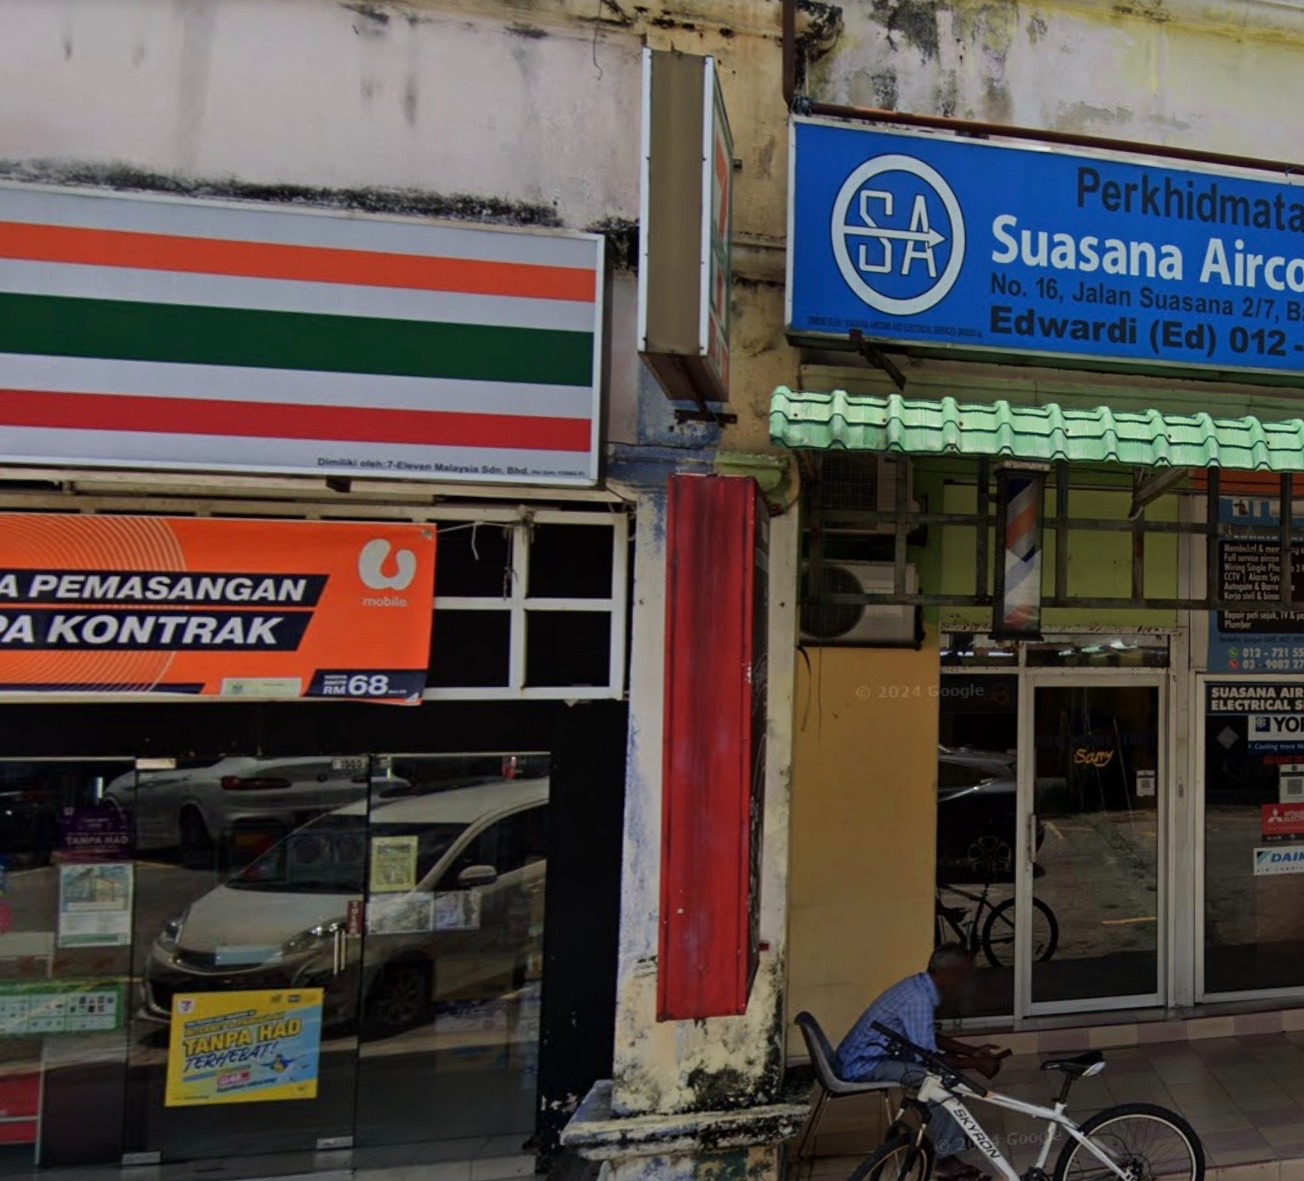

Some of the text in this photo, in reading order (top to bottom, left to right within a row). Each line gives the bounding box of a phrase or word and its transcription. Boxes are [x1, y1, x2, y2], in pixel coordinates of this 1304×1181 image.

[858, 189, 937, 278] SA
[992, 214, 1183, 280] Suasana
[991, 272, 1027, 297] No.
[1036, 277, 1064, 304] 16,
[1072, 281, 1132, 307] Jalan
[1140, 287, 1234, 316] Suasana
[1242, 297, 1280, 324] 2/7,
[990, 306, 1137, 345] Edwardi
[1150, 320, 1216, 357] (Ed)
[1230, 326, 1286, 356] 012
[317, 457, 358, 467] Dimiliki
[387, 460, 432, 472] 7-Eleven
[435, 463, 479, 475] Malaysia
[481, 466, 505, 475] Sdn.
[507, 466, 531, 476] Bhd.
[1224, 572, 1269, 581] CCTV Alarm
[28, 574, 306, 602] PEMASANGAN
[362, 596, 408, 608] mobile
[0, 614, 284, 645] A KONTRAK
[1242, 647, 1261, 658] 012
[1272, 647, 1289, 658] 721
[1242, 659, 1256, 669] 03
[1265, 659, 1290, 669] 9082
[323, 686, 346, 695] RM
[348, 674, 389, 696] 68
[1211, 687, 1277, 698] SUASANA
[1211, 699, 1291, 711] ELECTRICAL
[1254, 742, 1278, 752] Cooling
[65, 834, 129, 847] TANPA HAD
[183, 1029, 252, 1058] TANPA
[259, 1017, 302, 1041] HAD
[183, 1041, 279, 1073] TERHEBAT!
[953, 1108, 1001, 1159] SKYRON
